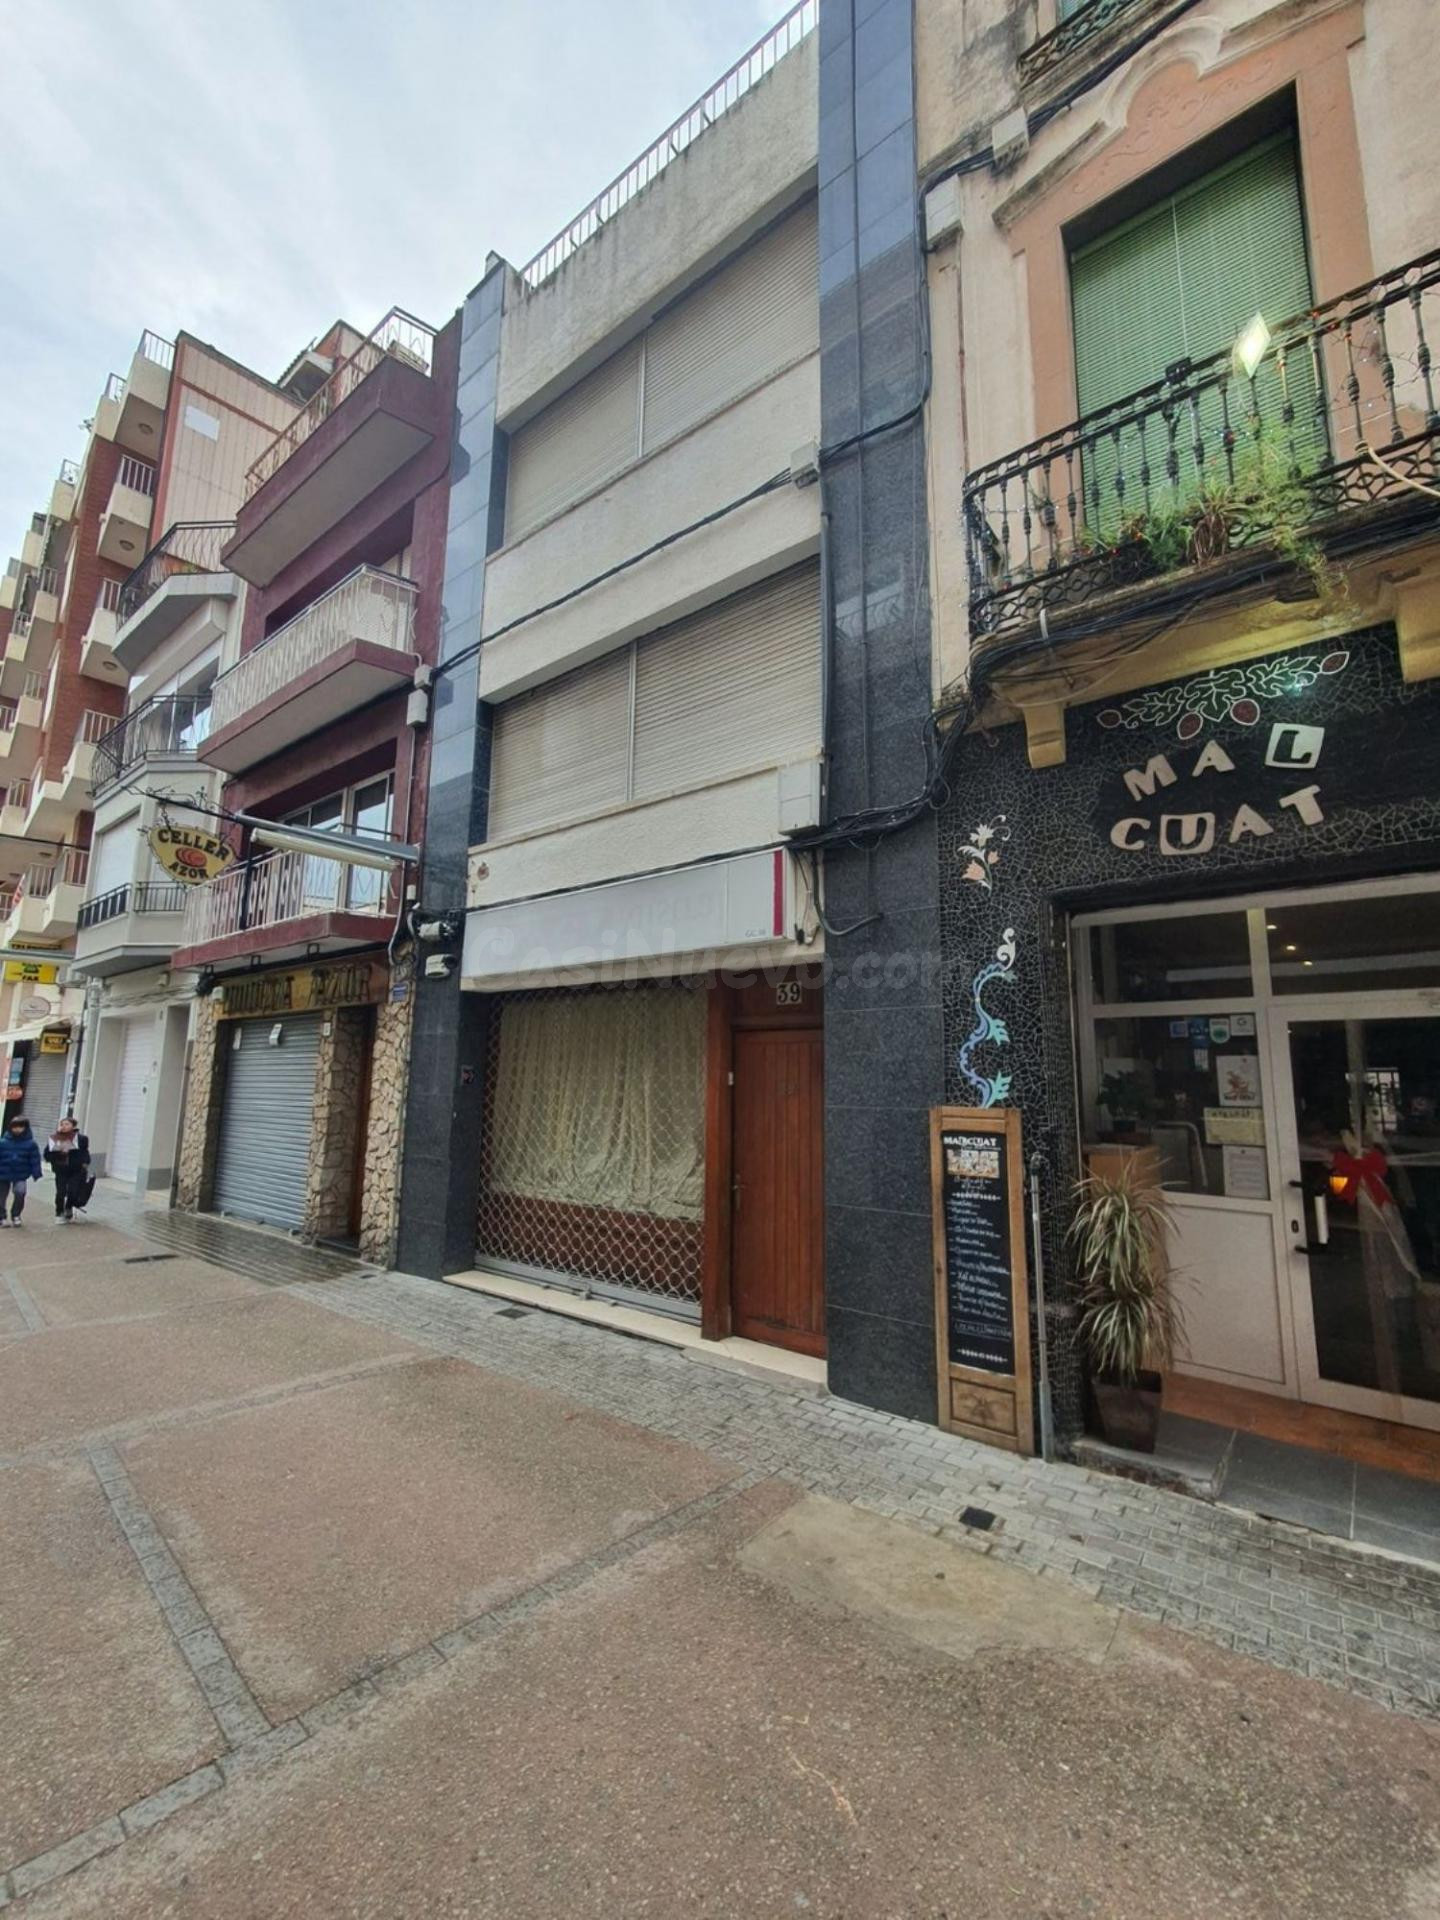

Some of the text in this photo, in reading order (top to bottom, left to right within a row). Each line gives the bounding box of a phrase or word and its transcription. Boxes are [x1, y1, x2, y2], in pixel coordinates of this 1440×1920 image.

[1122, 723, 1325, 802] MAL
[1110, 784, 1324, 857] CUAT
[157, 828, 230, 862] CELLER
[168, 861, 209, 879] AZOR
[778, 981, 801, 1003] 39
